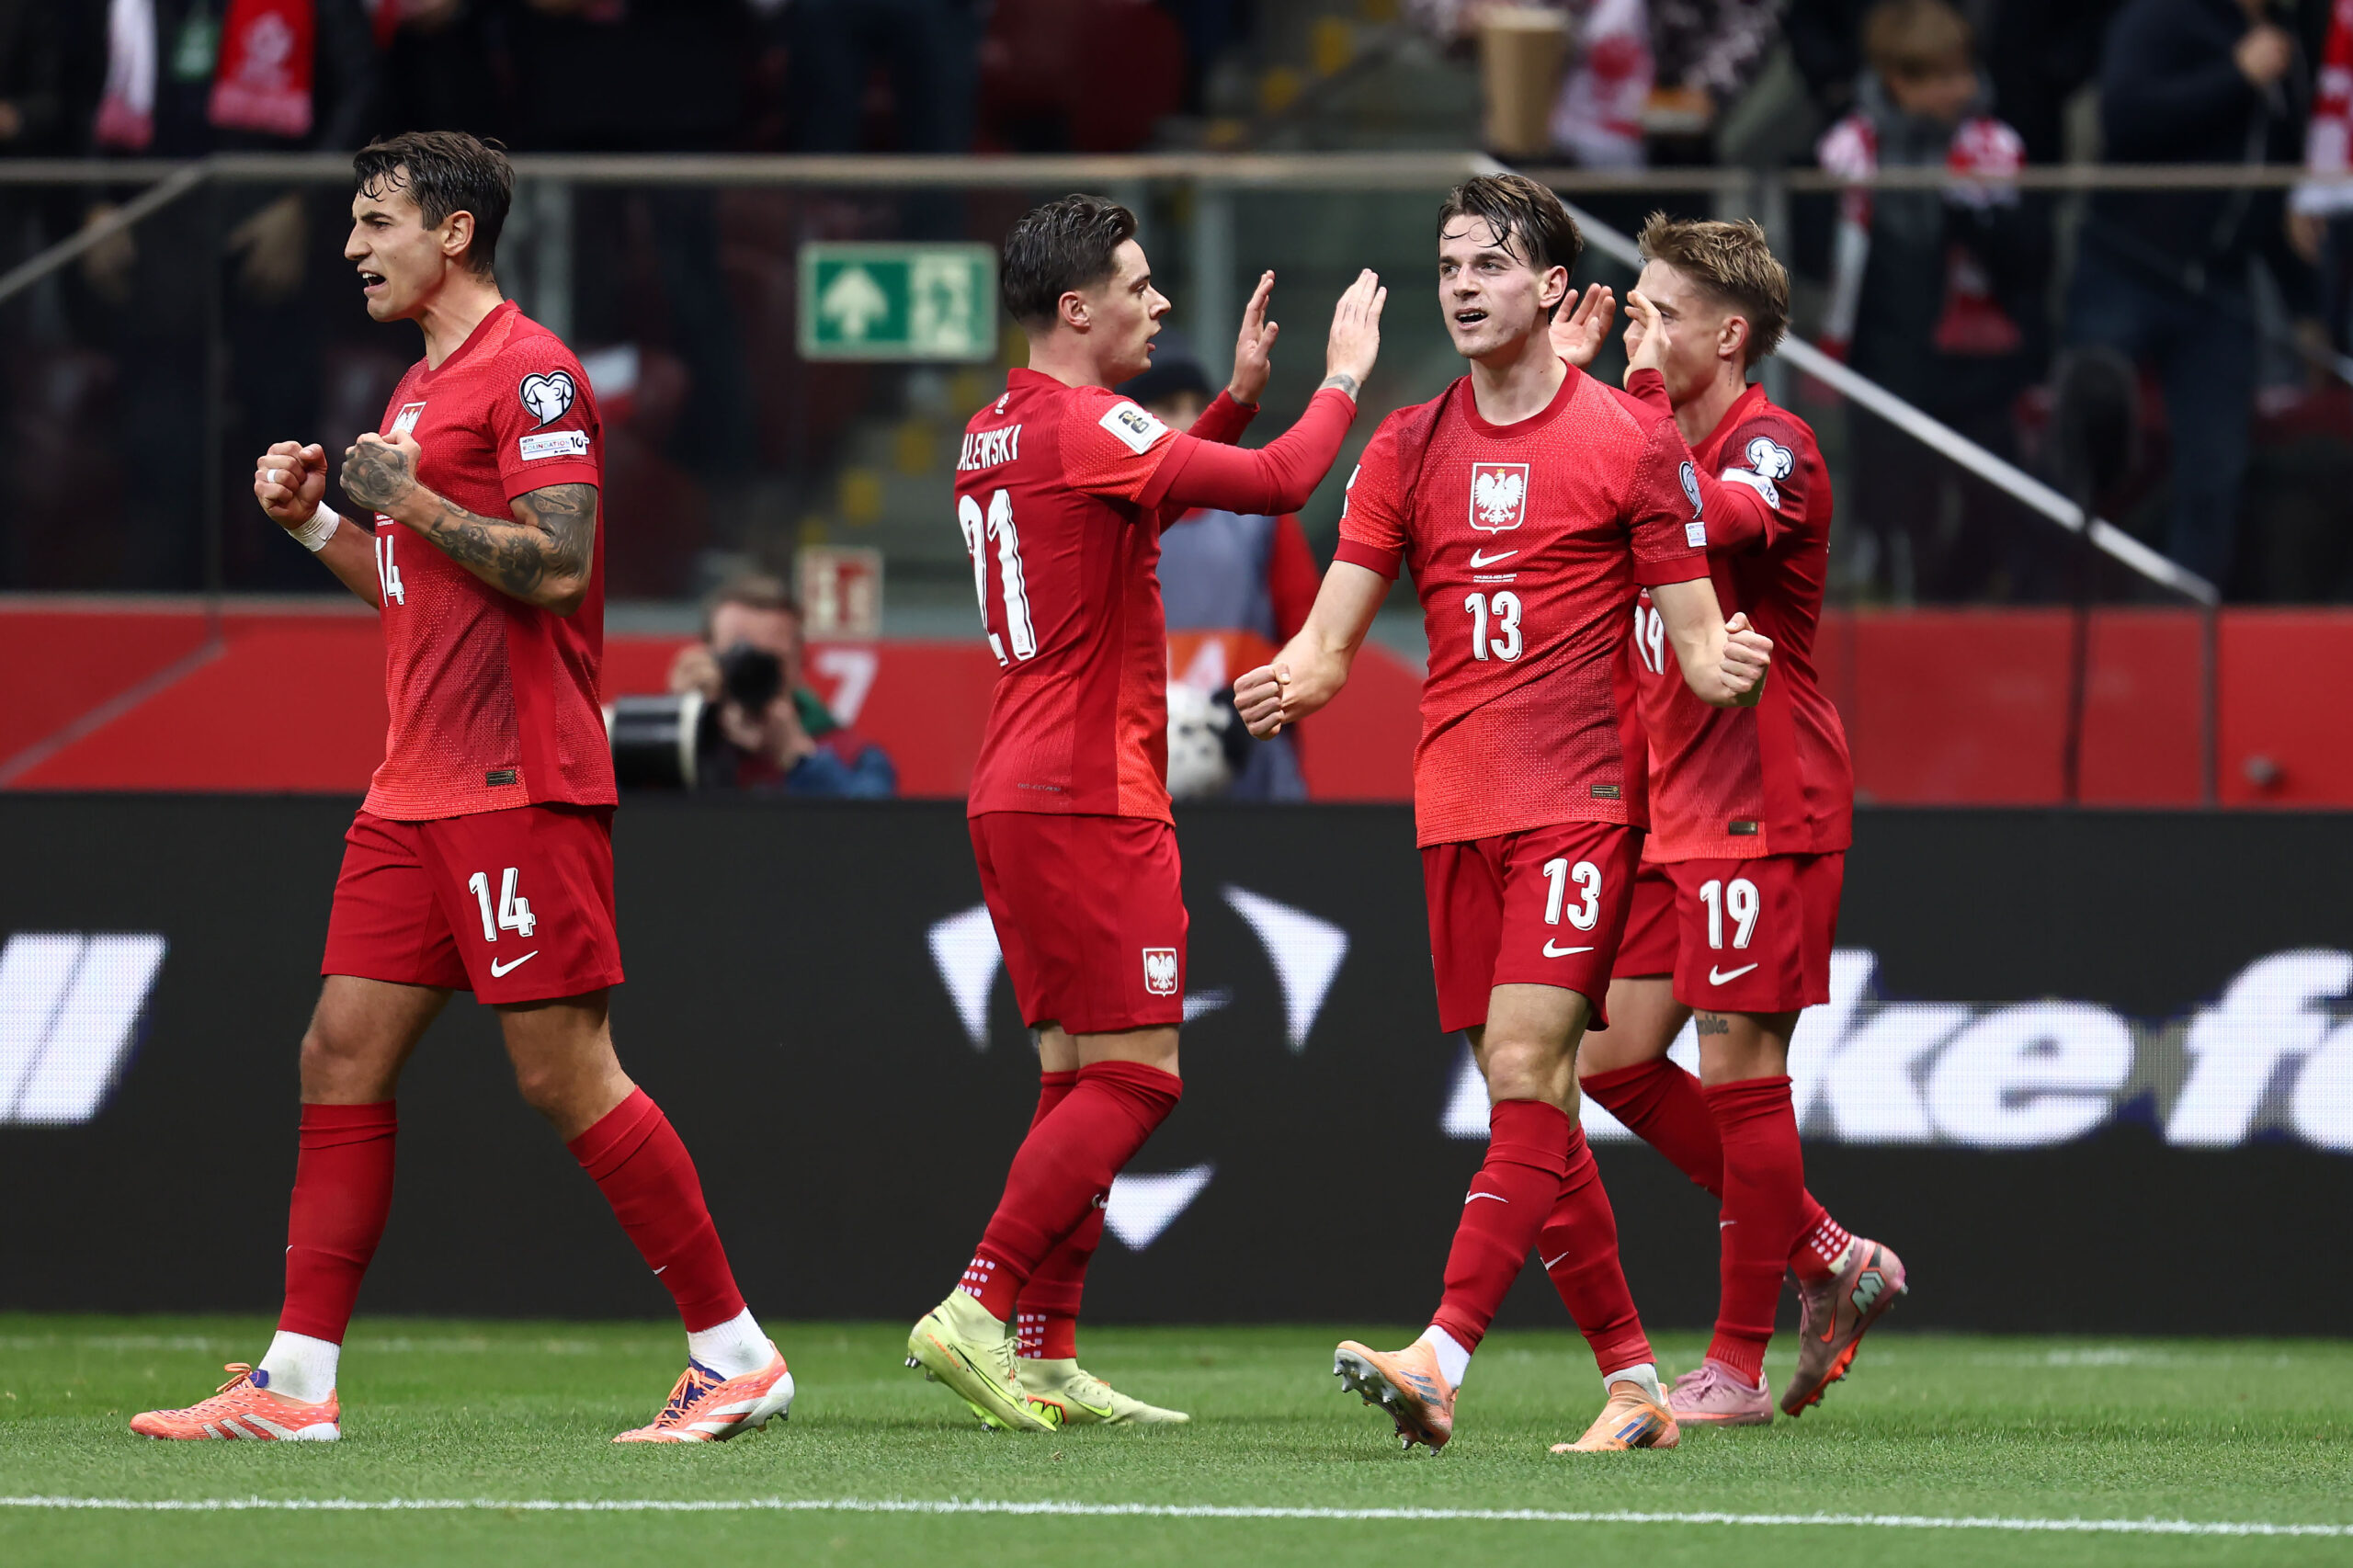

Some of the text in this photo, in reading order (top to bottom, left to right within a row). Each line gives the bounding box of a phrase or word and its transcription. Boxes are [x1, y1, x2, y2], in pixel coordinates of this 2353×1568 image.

[522, 439, 570, 451] FOUNDATION
[957, 424, 1022, 472] ALEWSKI
[375, 534, 405, 608] 14
[958, 488, 1037, 667] 21
[1464, 590, 1523, 663] 13
[815, 648, 879, 729] 7
[468, 867, 536, 942] 14
[1542, 858, 1601, 931] 13
[1699, 878, 1759, 949] 19
